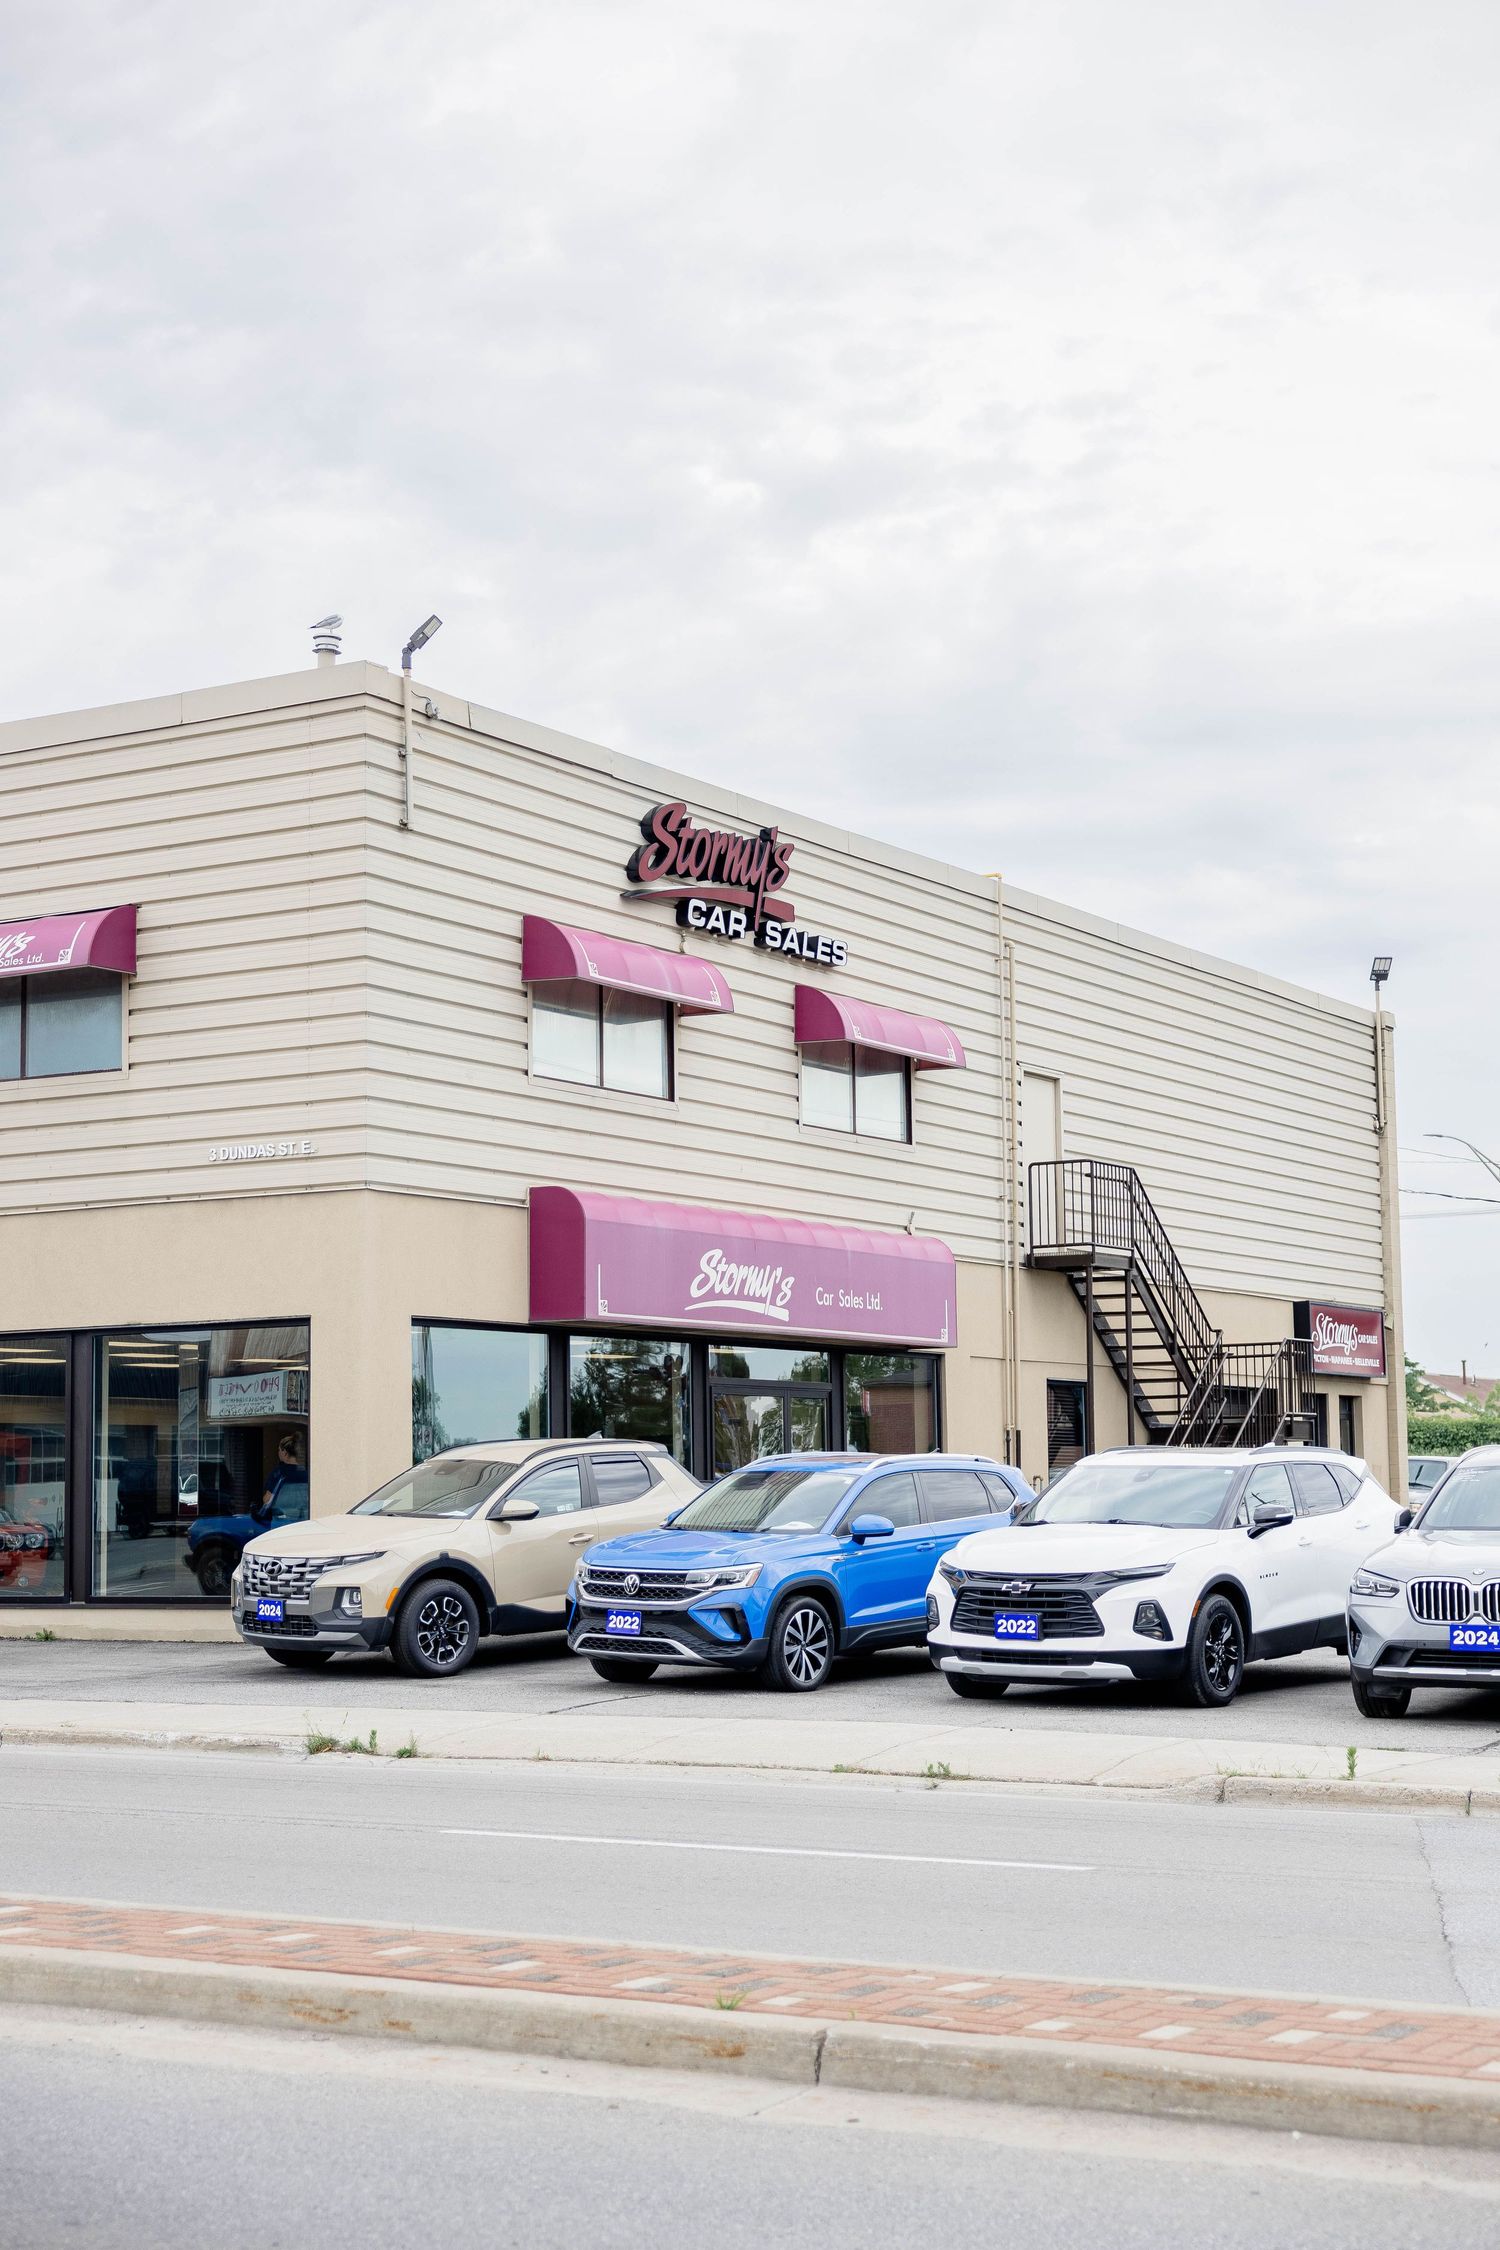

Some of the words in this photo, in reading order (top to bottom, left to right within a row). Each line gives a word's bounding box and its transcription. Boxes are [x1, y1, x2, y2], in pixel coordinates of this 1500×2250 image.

[638, 802, 795, 931] Stormy's
[687, 898, 747, 939] CAR
[765, 920, 849, 966] SALES
[27, 952, 44, 965] Ltd.
[208, 1148, 218, 1161] 3
[220, 1143, 276, 1160] DUNDAS
[279, 1141, 299, 1156] ST.
[301, 1140, 316, 1154] E.
[690, 1248, 795, 1315] Stormy's
[816, 1286, 834, 1307] Car
[838, 1288, 864, 1310] Sales
[866, 1291, 884, 1312] Ltd.
[258, 1603, 282, 1617] 2024
[608, 1614, 640, 1630] 2022
[997, 1618, 1036, 1634] 2022
[1452, 1629, 1500, 1646] 2024
